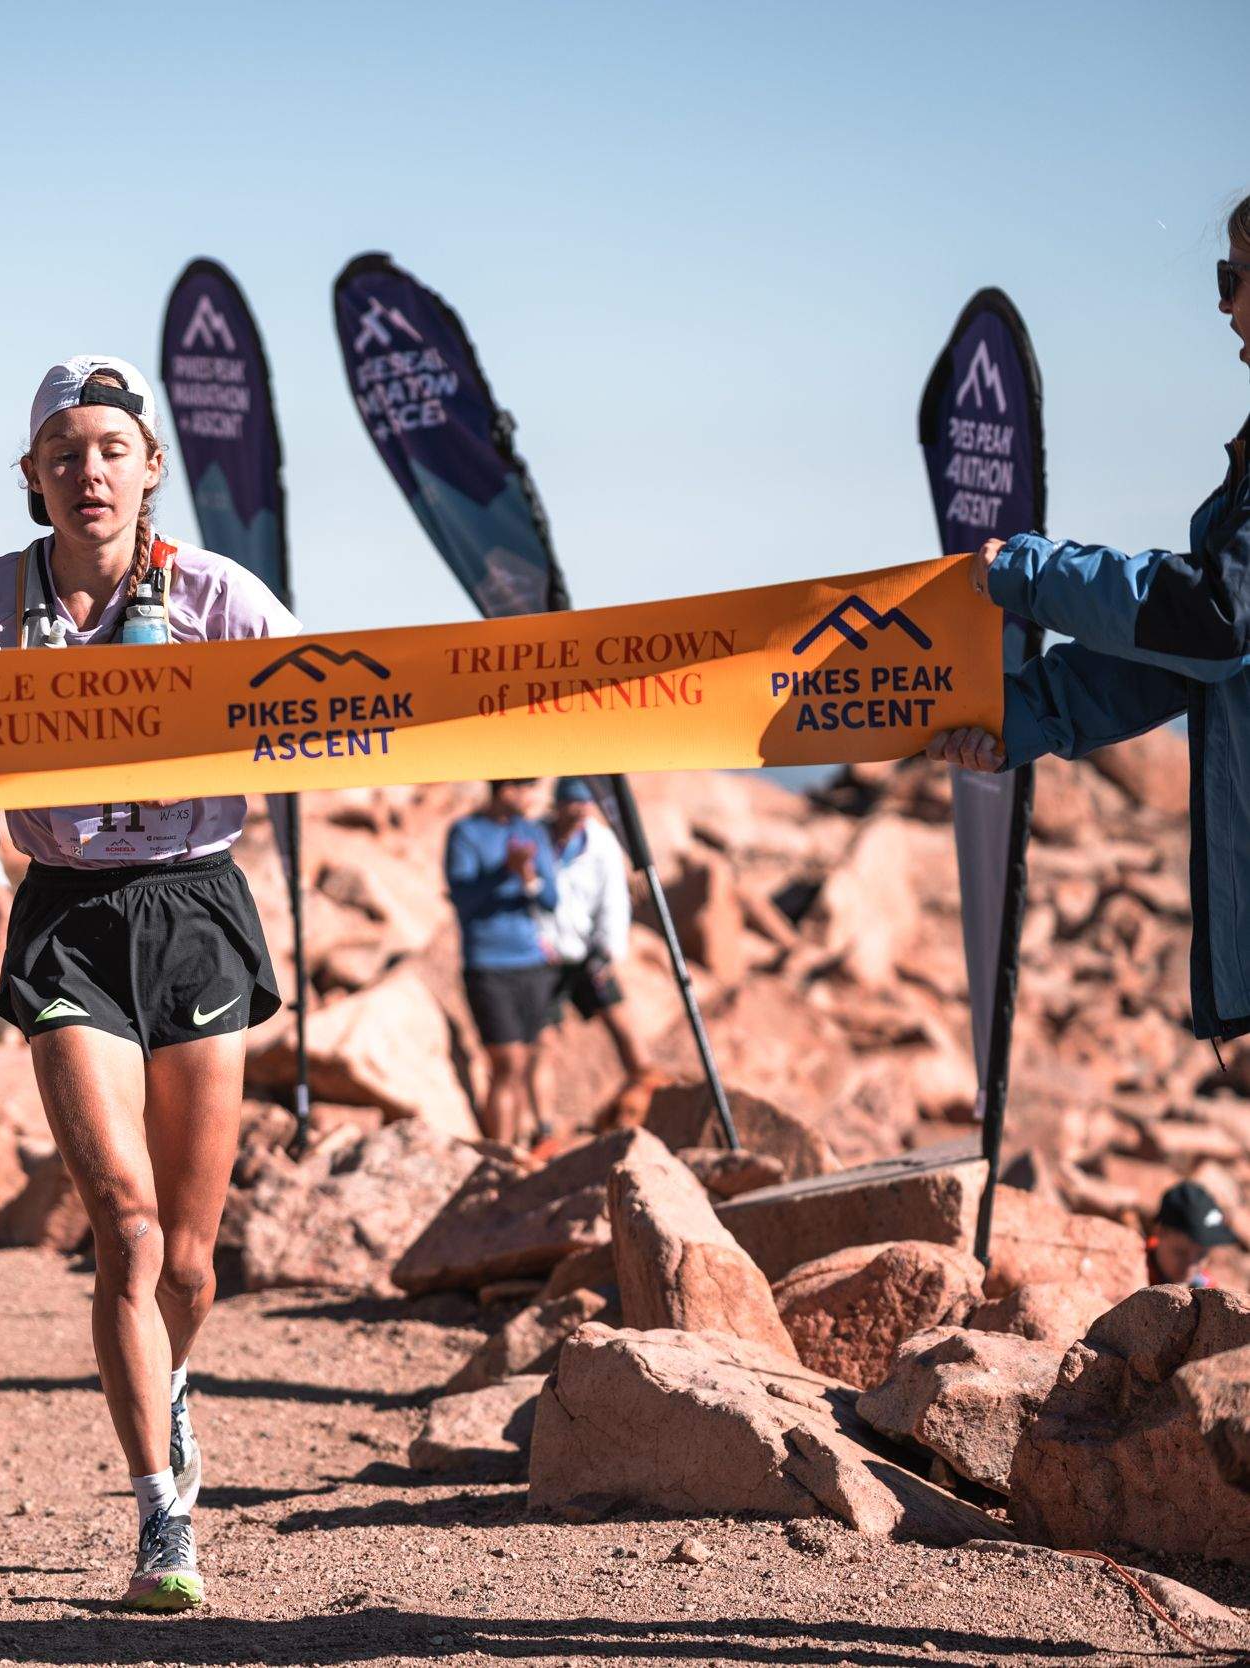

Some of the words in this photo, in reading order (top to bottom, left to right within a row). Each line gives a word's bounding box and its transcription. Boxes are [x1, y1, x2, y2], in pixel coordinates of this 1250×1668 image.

[445, 639, 580, 674] TRIPLE
[595, 628, 740, 666] CROWN
[50, 665, 194, 700] CROWN
[478, 684, 510, 717] of
[526, 672, 703, 715] RUNNING
[771, 668, 861, 697] PIKES
[870, 665, 954, 693] PEAK
[227, 698, 319, 729] PIKES
[329, 692, 414, 722] PEAK
[795, 698, 937, 732] ASCENT
[252, 726, 396, 762] ASCENT
[159, 808, 191, 822] W-XS
